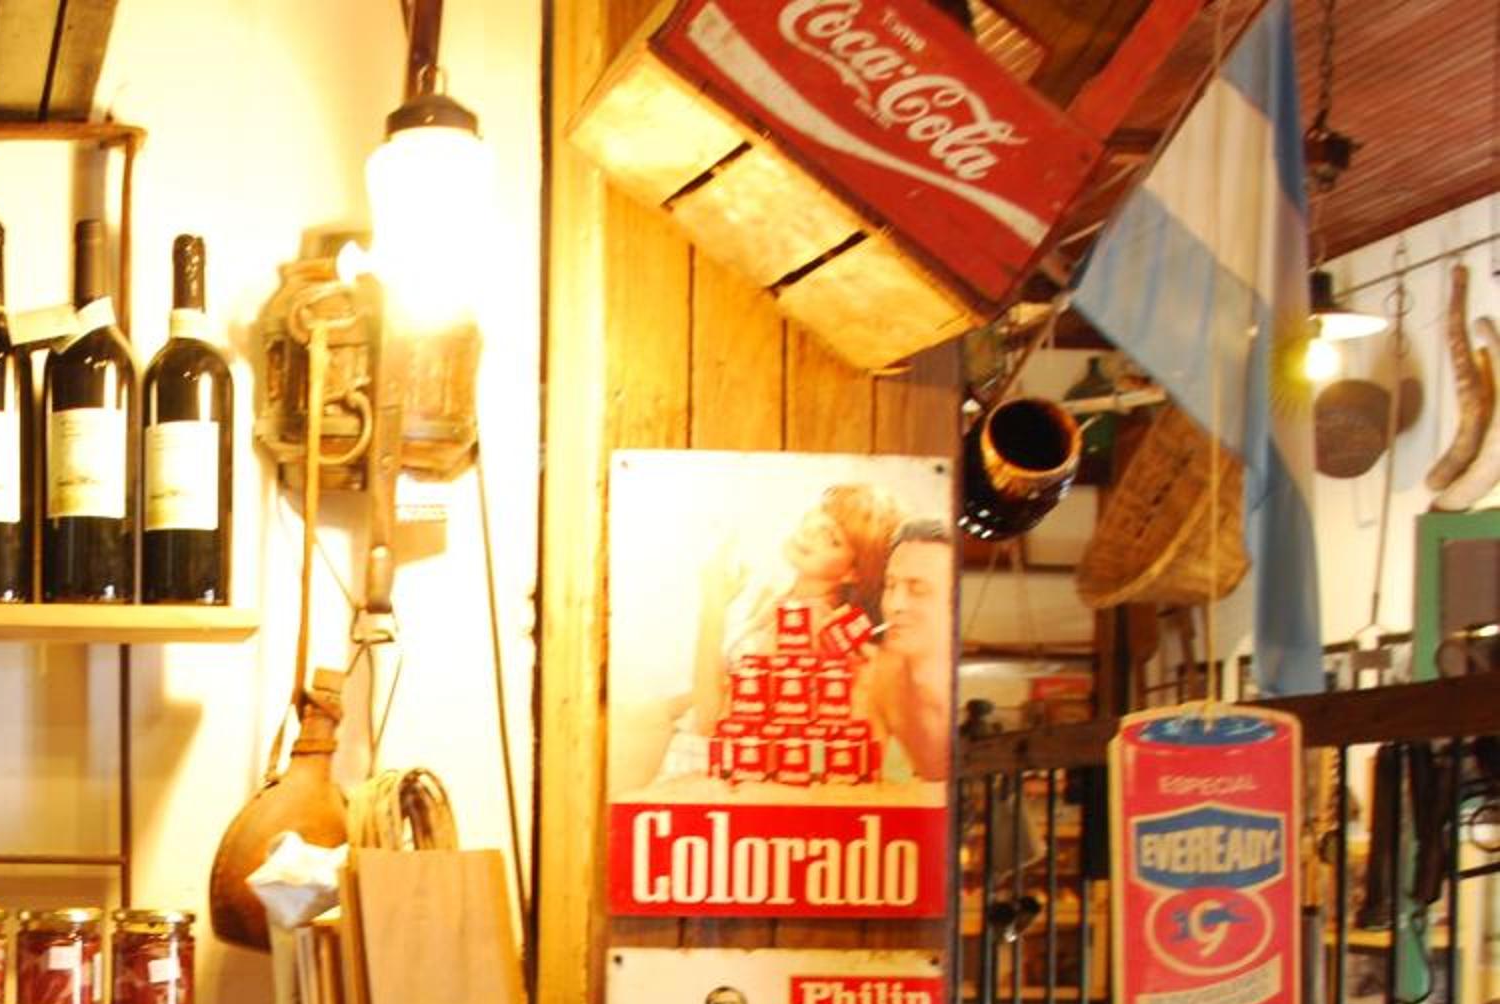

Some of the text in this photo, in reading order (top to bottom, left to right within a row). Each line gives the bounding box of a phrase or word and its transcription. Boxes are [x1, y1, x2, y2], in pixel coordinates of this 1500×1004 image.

[1158, 775, 1259, 796] ESPECIAL
[632, 809, 920, 906] Colorado
[1140, 826, 1278, 873] EVEREADY
